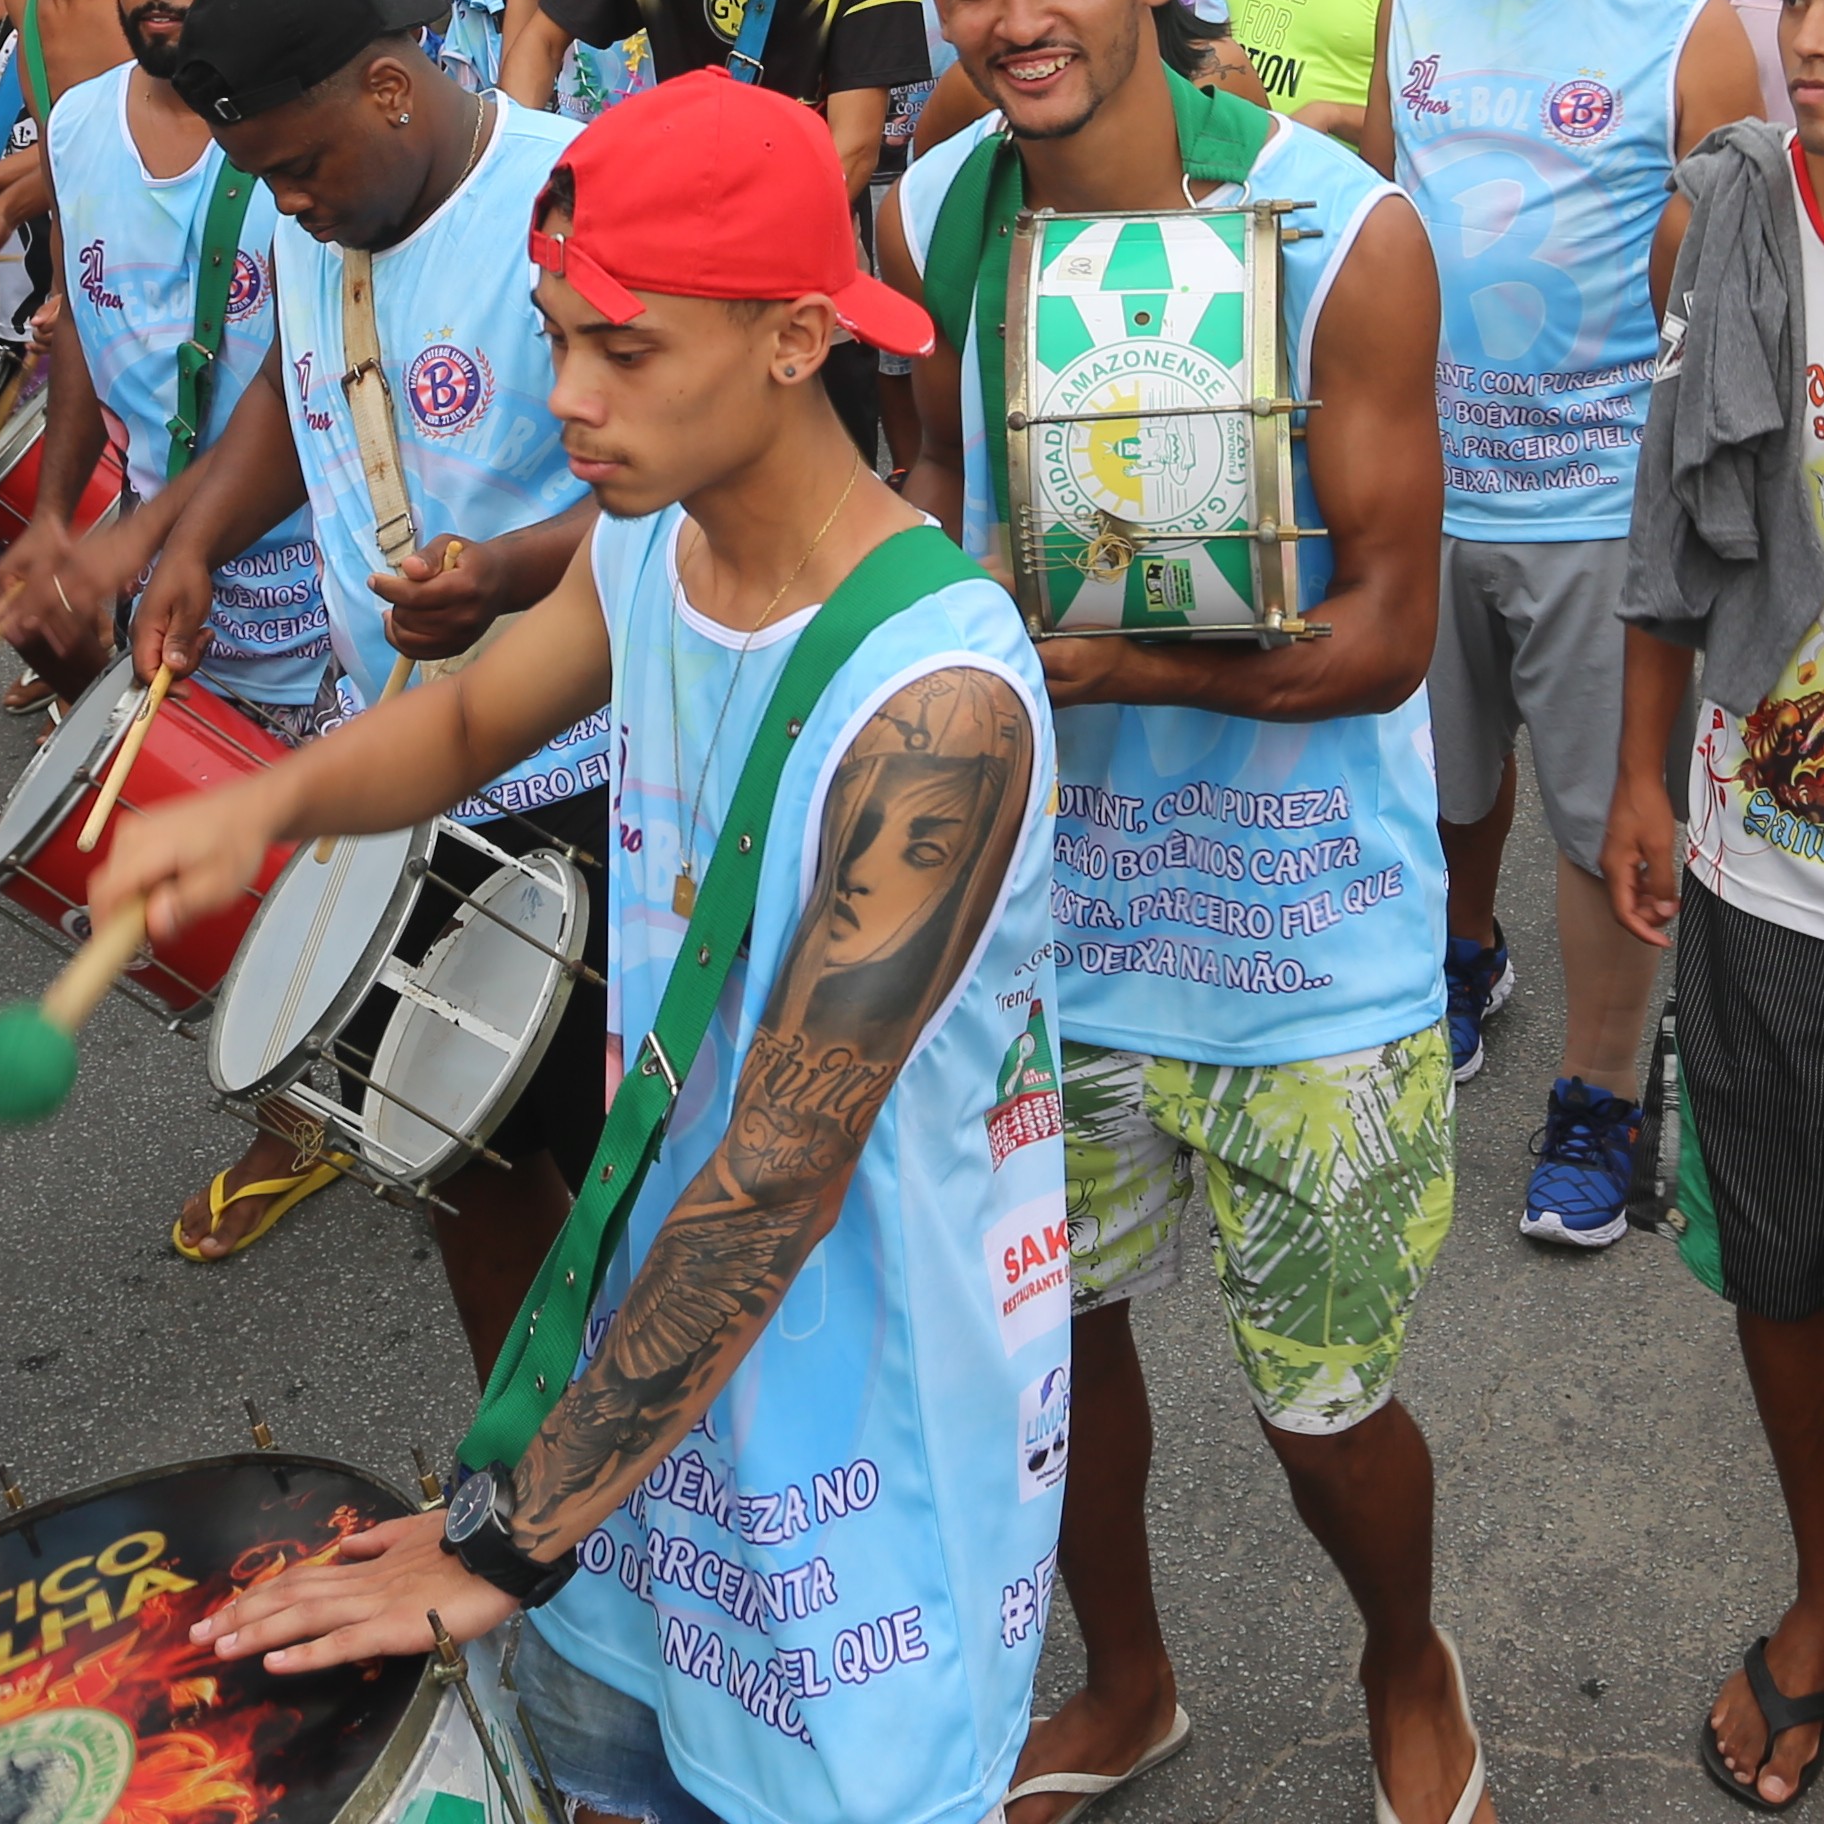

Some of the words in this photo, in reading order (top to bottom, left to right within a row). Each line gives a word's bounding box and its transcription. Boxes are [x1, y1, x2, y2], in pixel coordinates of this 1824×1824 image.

[1239, 0, 1292, 49] FOR
[1060, 349, 1226, 410] AMAZONENSE
[1480, 370, 1536, 397] COM
[1539, 367, 1624, 396] PUREZA
[1455, 402, 1560, 428] BOÊMIOS
[1565, 395, 1633, 426] CANTA
[1463, 432, 1579, 461] PARCEIRO
[1583, 426, 1630, 450] FIEL
[1444, 464, 1501, 493] DEIXA
[1505, 470, 1540, 492] NA
[1544, 463, 1618, 491] MÃO...
[1222, 785, 1349, 830] PUREZA
[1113, 830, 1244, 881] BOÊMIOS
[1250, 837, 1360, 885] CANTA
[1281, 892, 1342, 939] FIEL
[1343, 862, 1403, 914] QUE
[1079, 939, 1175, 976] DEIXA
[1181, 945, 1221, 986] NA
[1225, 946, 1333, 994] MÃO...
[1002, 1270, 1063, 1317] RESTAURANTE
[812, 1459, 878, 1524] NO
[664, 1617, 724, 1687] NA
[833, 1607, 928, 1684] QUE
